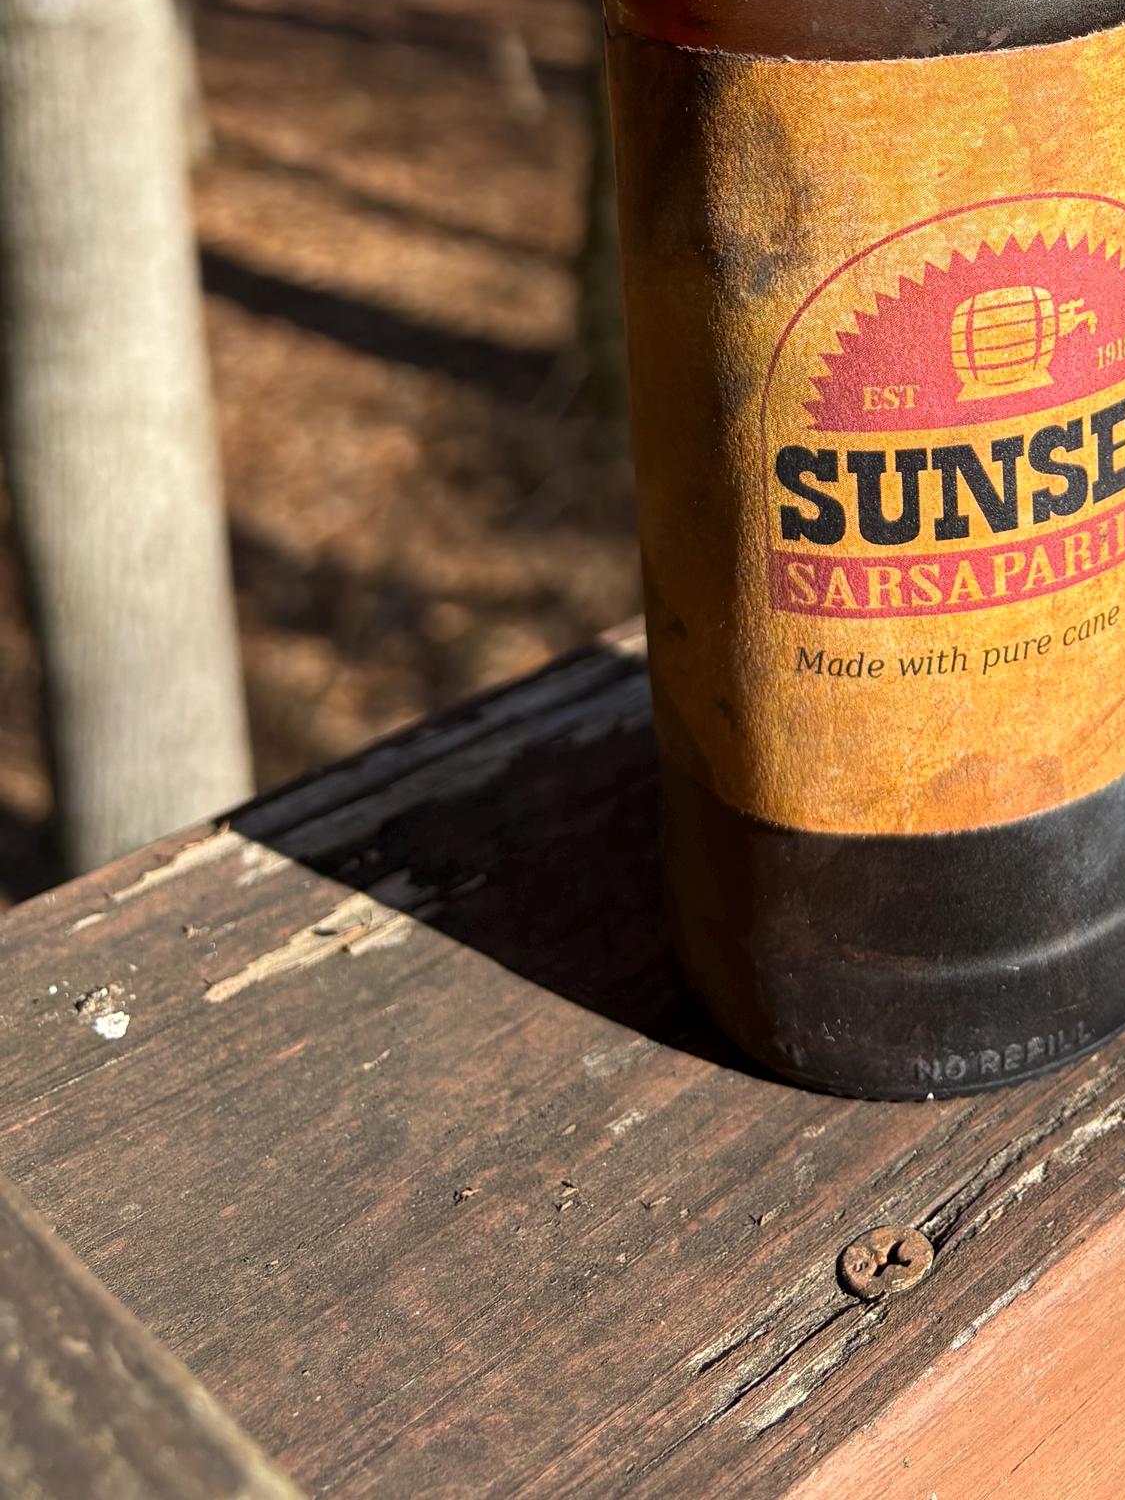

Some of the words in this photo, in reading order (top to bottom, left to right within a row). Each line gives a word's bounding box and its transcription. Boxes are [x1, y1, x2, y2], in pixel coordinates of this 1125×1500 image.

[863, 385, 920, 410] EST
[796, 647, 885, 678] Made
[898, 646, 968, 676] with
[982, 633, 1051, 675] pure
[1062, 604, 1119, 647] cane
[914, 1054, 967, 1082] NO
